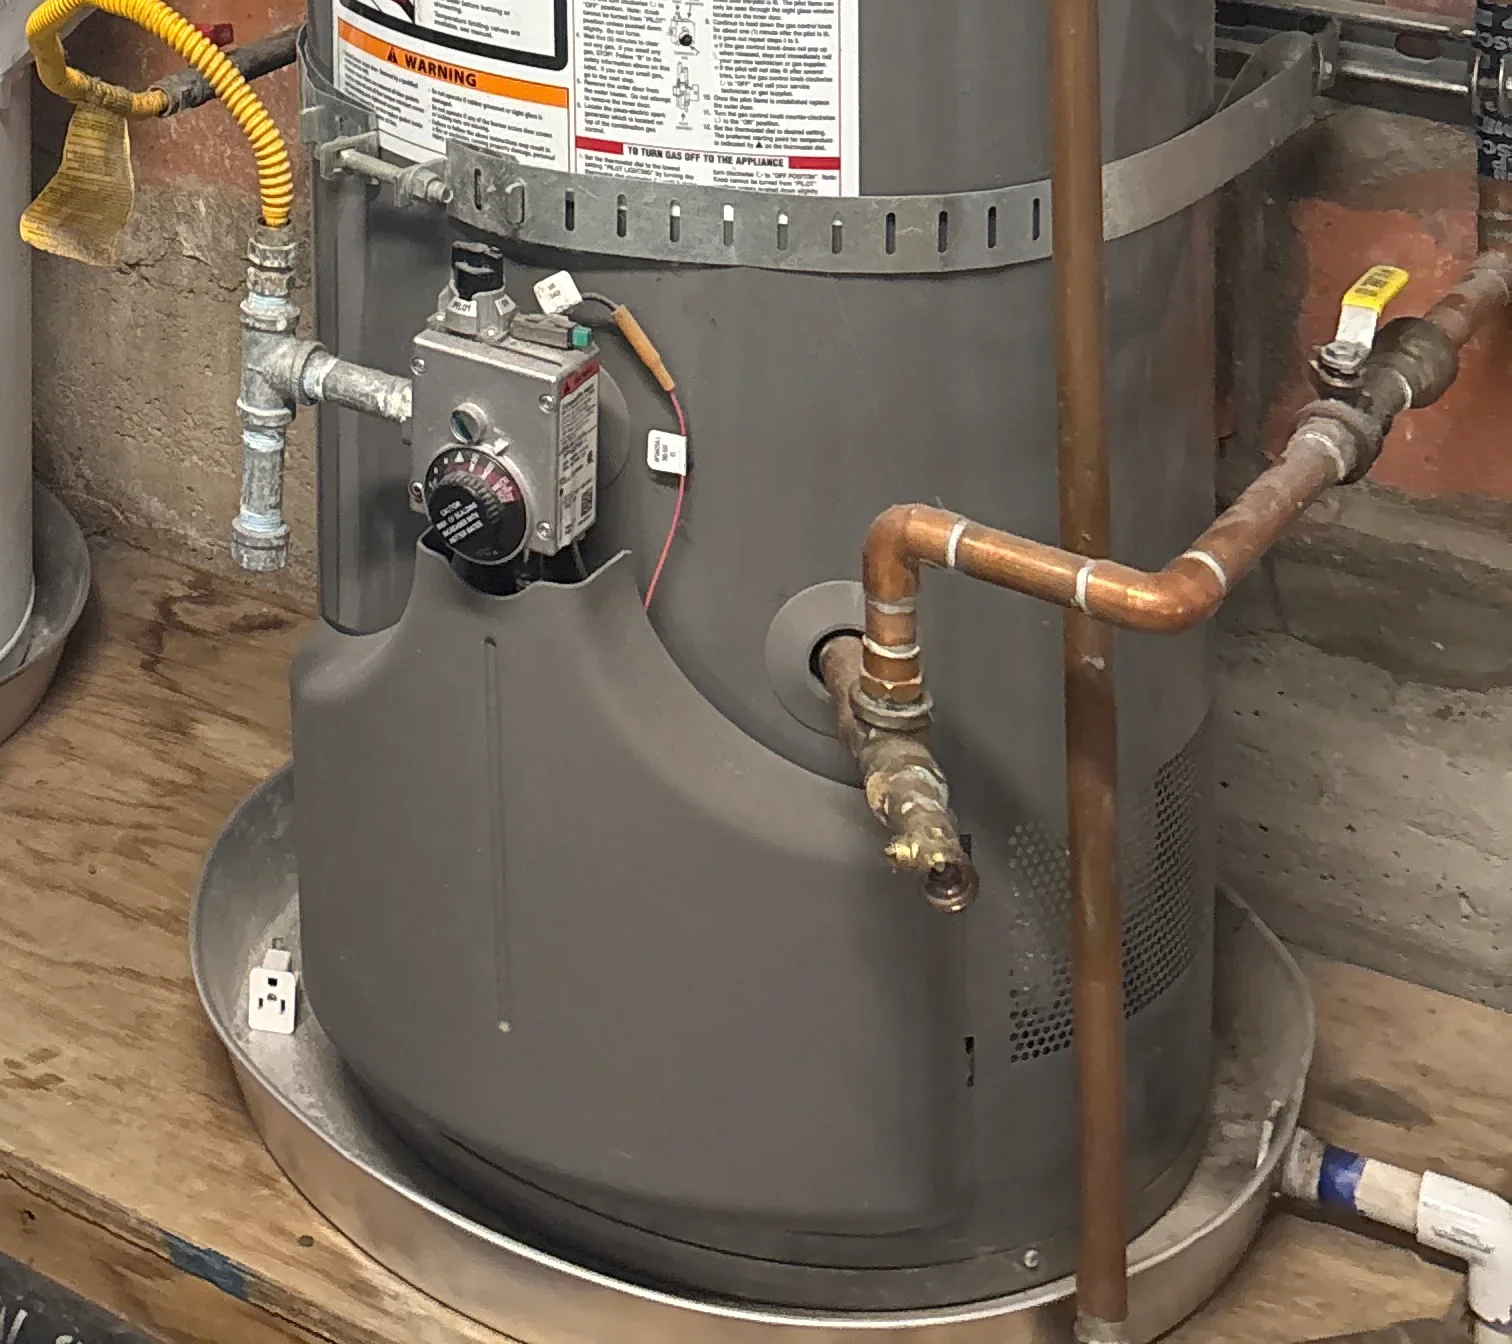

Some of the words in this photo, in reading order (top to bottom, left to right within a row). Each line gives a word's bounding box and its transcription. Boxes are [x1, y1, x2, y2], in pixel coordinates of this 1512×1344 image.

[405, 54, 477, 87] WARNING
[627, 146, 638, 155] TO
[640, 147, 663, 158] TURN
[665, 150, 683, 160] GAS
[685, 152, 700, 161] OFF
[703, 153, 715, 163] TO
[717, 154, 733, 164] THE
[736, 156, 784, 168] APPLIANCE
